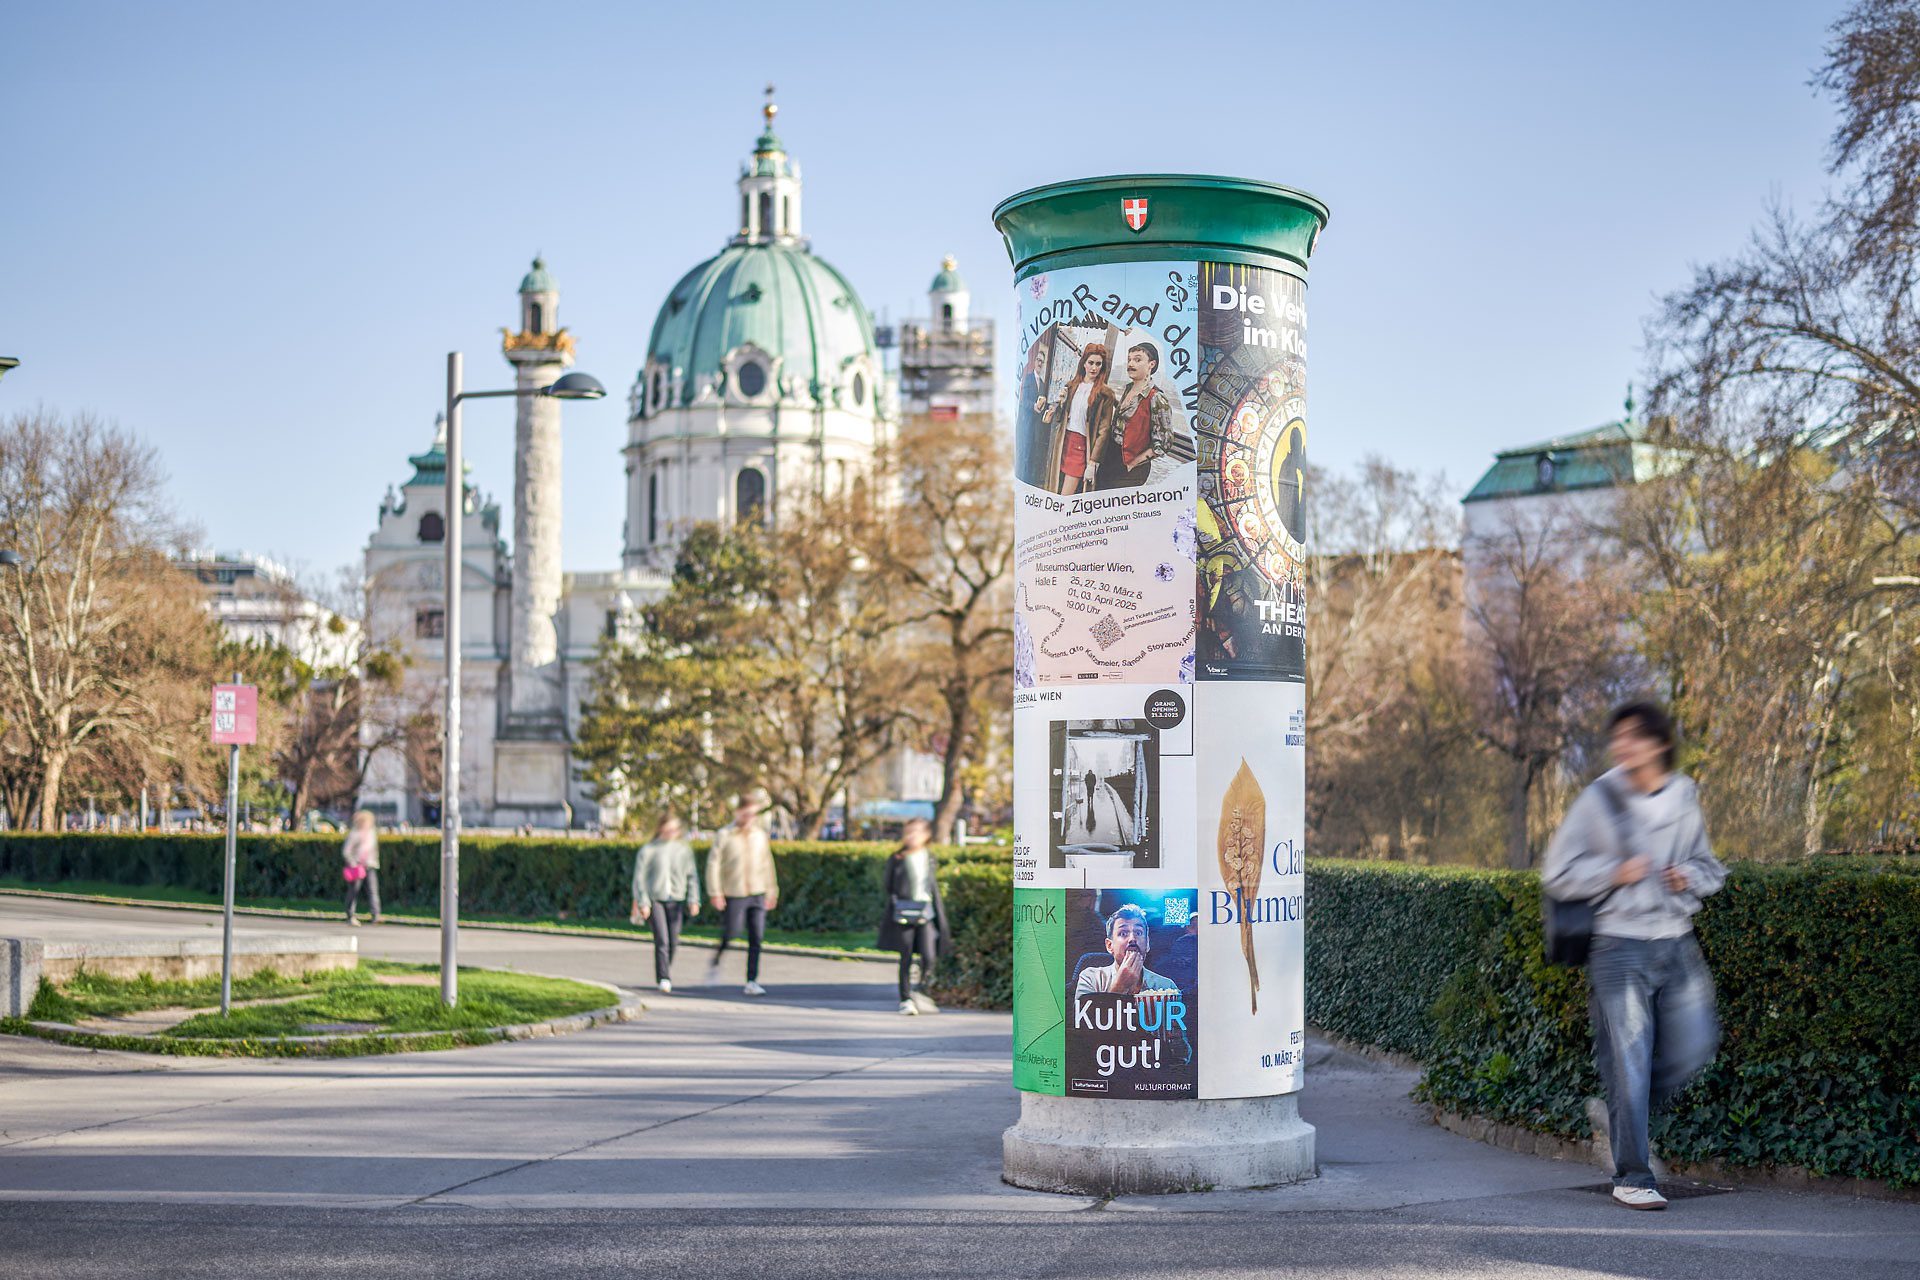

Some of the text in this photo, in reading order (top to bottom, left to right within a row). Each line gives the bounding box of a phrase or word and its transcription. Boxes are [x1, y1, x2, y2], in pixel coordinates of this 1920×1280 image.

[1213, 284, 1266, 315] Die
[1029, 299, 1073, 336] vom
[1163, 324, 1193, 380] der
[1243, 318, 1277, 348] im
[1024, 494, 1043, 508] oder
[1044, 497, 1065, 512] Der
[1132, 509, 1162, 520] Strauss
[1035, 562, 1105, 573] MuseumsQuartier
[1106, 562, 1135, 574] Wien,
[1051, 577, 1057, 586] E
[1113, 586, 1135, 599] März
[1136, 591, 1143, 600] &
[1086, 604, 1101, 615] Uhr
[1094, 595, 1114, 605] April
[1114, 598, 1137, 611] 2025
[1261, 623, 1302, 638] AN DER
[1039, 691, 1062, 701] WIEN
[1074, 999, 1187, 1032] KultUR
[1096, 1038, 1161, 1077] gut!
[1261, 1054, 1273, 1068] 10.
[1134, 1083, 1192, 1091] KULTURFORMAT
